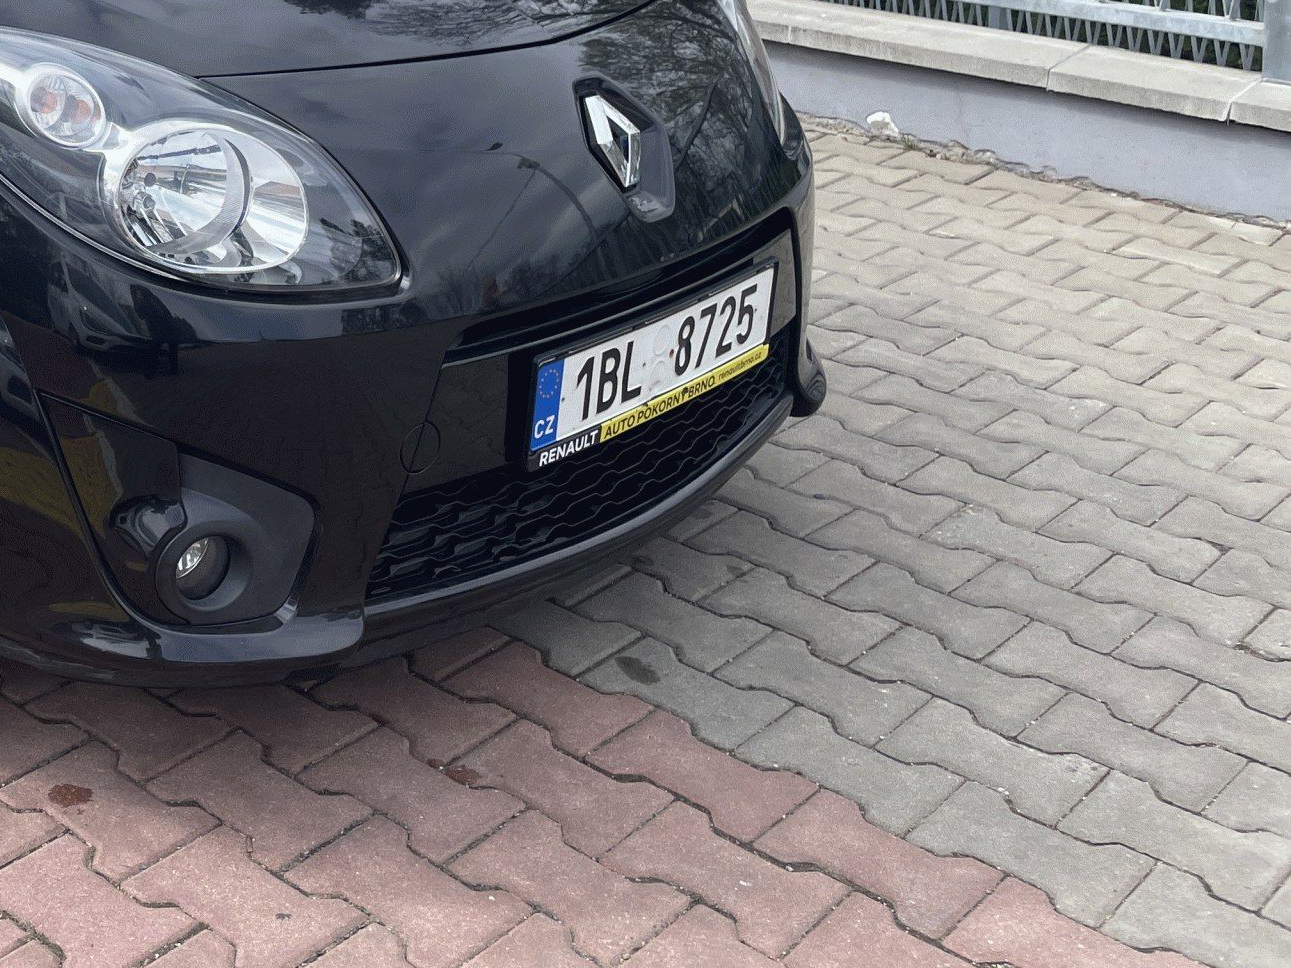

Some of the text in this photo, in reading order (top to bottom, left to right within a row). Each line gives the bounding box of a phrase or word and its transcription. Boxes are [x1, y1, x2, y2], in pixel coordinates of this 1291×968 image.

[575, 283, 758, 421] 1BL 8725
[534, 414, 555, 439] CZ
[604, 414, 636, 439] AUTO
[687, 375, 716, 399] BRNO
[538, 429, 599, 467] RENAULT
